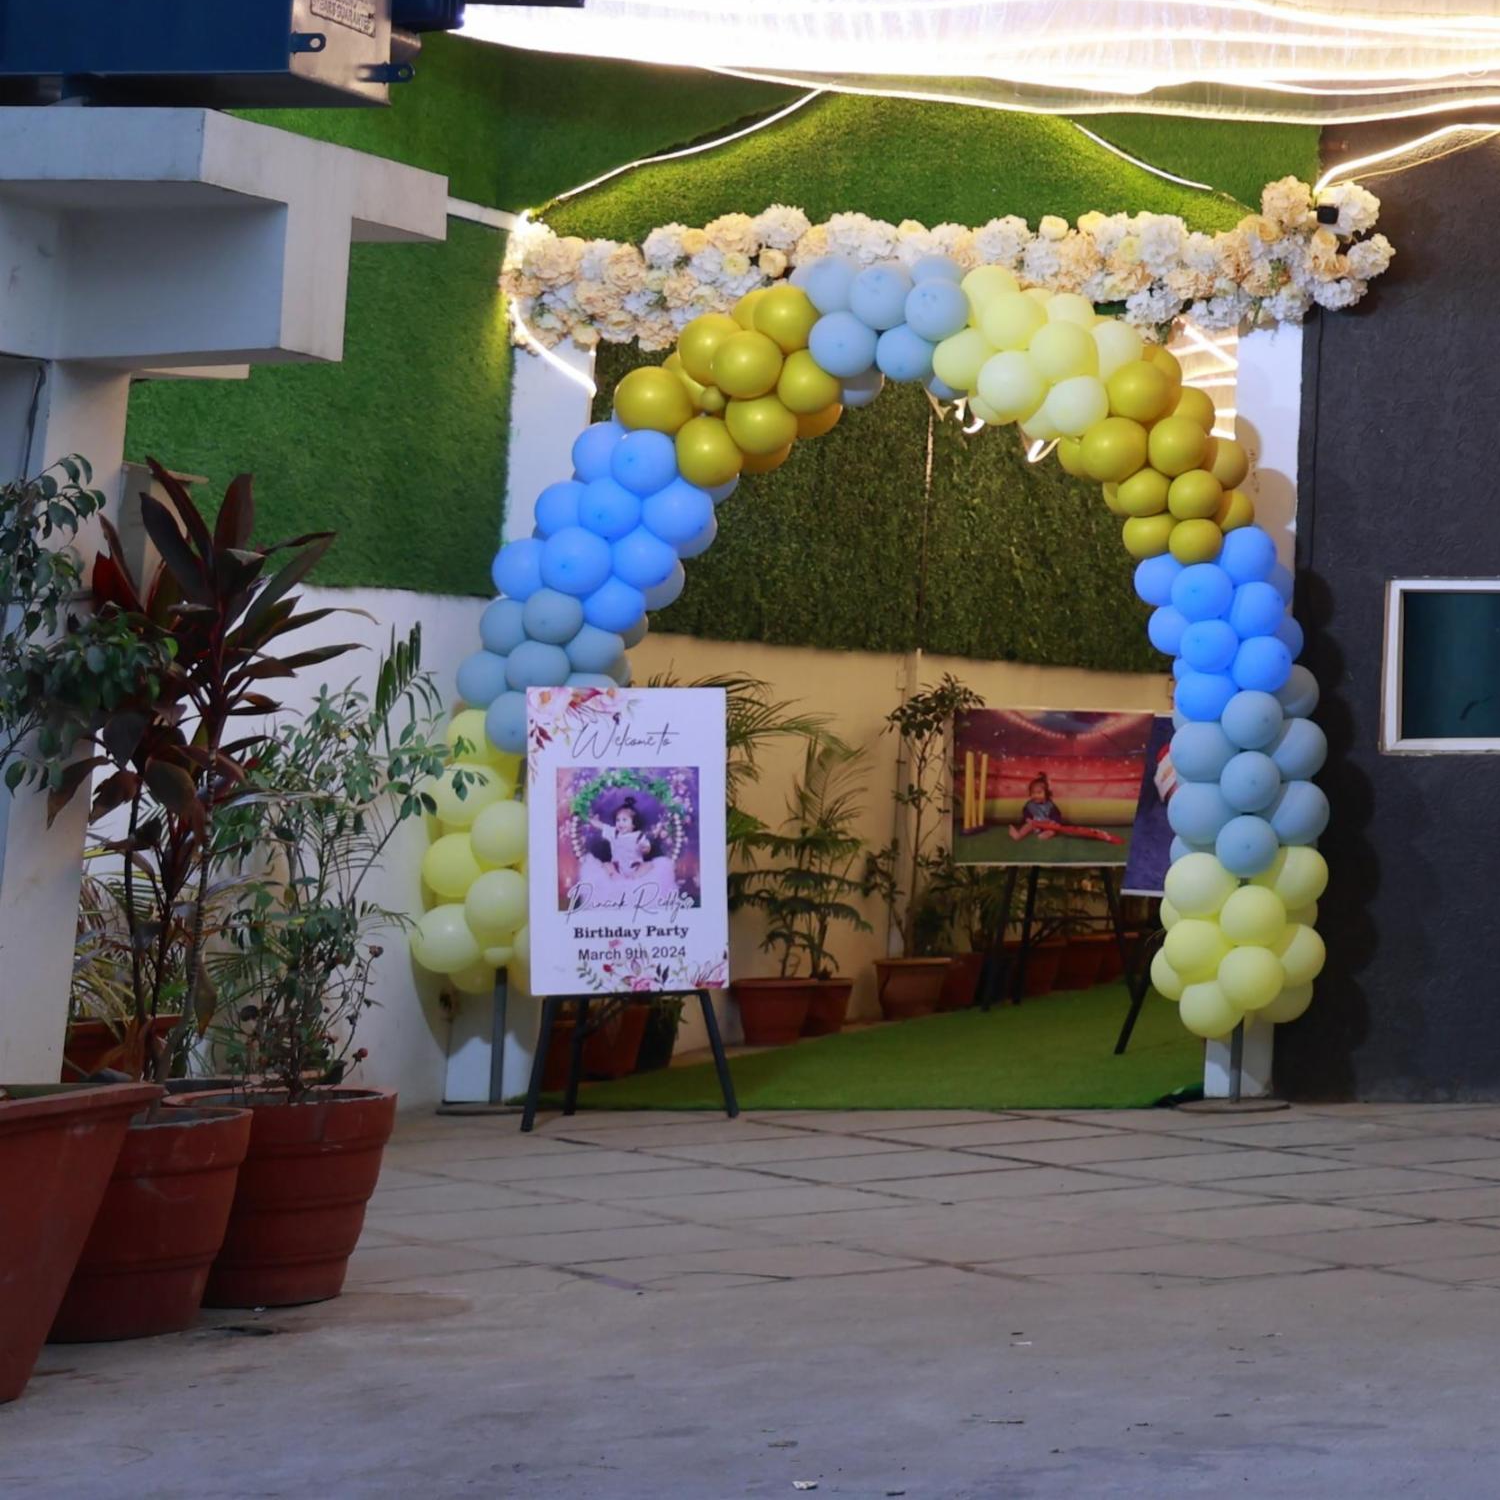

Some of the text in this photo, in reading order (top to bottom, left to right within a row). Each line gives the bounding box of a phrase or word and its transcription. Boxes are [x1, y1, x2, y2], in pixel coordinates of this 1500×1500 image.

[572, 721, 681, 760] Welcome to
[573, 925, 689, 940] Birthday Party
[578, 945, 686, 961] March 9th 2024
